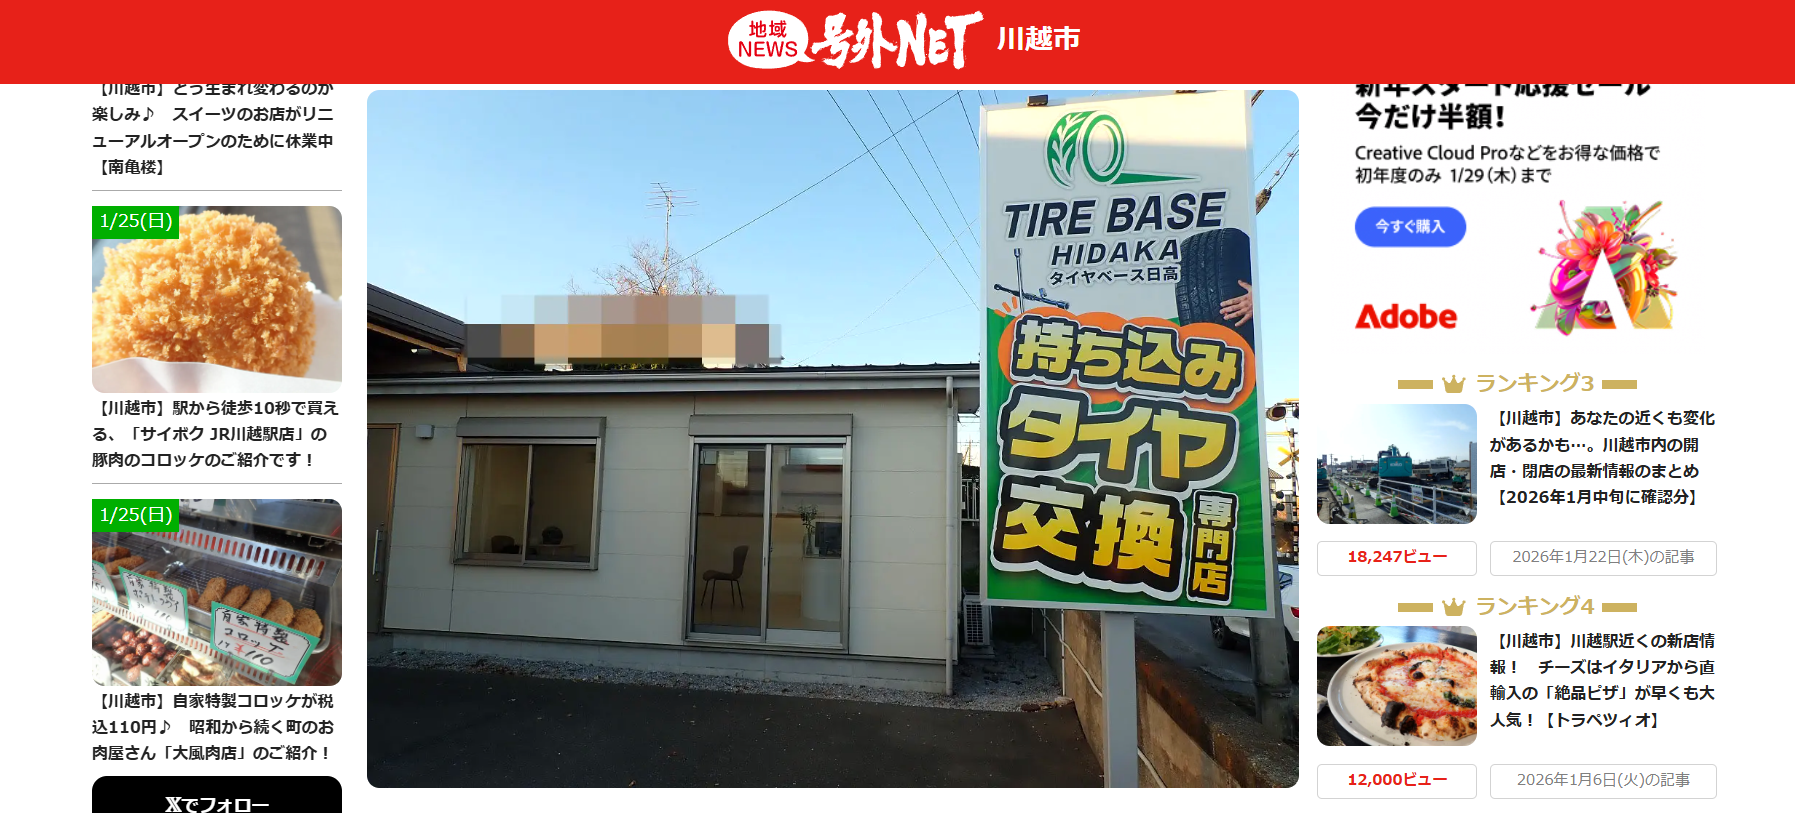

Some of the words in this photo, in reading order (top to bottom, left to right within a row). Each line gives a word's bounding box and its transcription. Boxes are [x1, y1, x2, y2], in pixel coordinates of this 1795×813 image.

[749, 20, 787, 37] 地域
[997, 26, 1080, 51] 川越市
[738, 41, 797, 58] NEWS
[173, 106, 333, 122] スイーツのお店がリニ
[1355, 102, 1505, 130] 今だけ半額！
[92, 133, 333, 149] ューアルオープンのために休業中
[1355, 145, 1422, 161] Creative
[1427, 145, 1475, 161] Cloud
[1480, 144, 1661, 162] Proなどをお得な価格で
[101, 159, 163, 176] 【南亀楼】
[1355, 167, 1442, 184] 初年度のみ
[101, 213, 173, 231] 1/25(日)
[1004, 199, 1097, 239] TIRE
[1106, 190, 1227, 234] BASE
[1375, 218, 1446, 235] 今すぐ購入
[1050, 238, 1181, 266] HIDAKA
[1049, 265, 1181, 286] タイヤベース日高
[1355, 304, 1458, 330] Adobe
[1014, 317, 1240, 392] 持ち込み
[1477, 372, 1595, 393] ランキング3
[101, 400, 339, 417] 【川越市】駅から徒歩10秒で買え
[1499, 410, 1716, 427] 【川越市】あなたの近くも変化
[1007, 392, 1228, 480] タイヤ
[92, 452, 312, 468] 豚肉のコロッケのご紹介です！
[1489, 463, 1700, 479] 店・閉店の最新情報のまとめ
[1499, 488, 1696, 506] 【2026年1月中旬に確認分】
[101, 507, 173, 526] 1/25(日)
[1001, 482, 1176, 579] 交換
[1191, 494, 1234, 596] 専門店
[1348, 549, 1448, 565] 18,247ビュー
[1512, 548, 1695, 566] 2026年1月22日(木)の記事
[1477, 595, 1595, 616] ランキング4
[1499, 633, 1716, 650] 【川越市】川越駅近くの新店情
[1537, 659, 1716, 676] チーズはイタリアから直
[101, 693, 333, 710] 【川越市】自家特製コロッケが税
[1489, 685, 1716, 701] 輸入の「絶品ピザ」が早くも大
[189, 719, 334, 735] 昭和から続く町のお
[92, 745, 328, 761] 肉屋さん「大風肉店」のご紹介！
[1348, 772, 1448, 788] 12,000ビュー
[1516, 771, 1691, 789] 2026年1月6日(火)の記事
